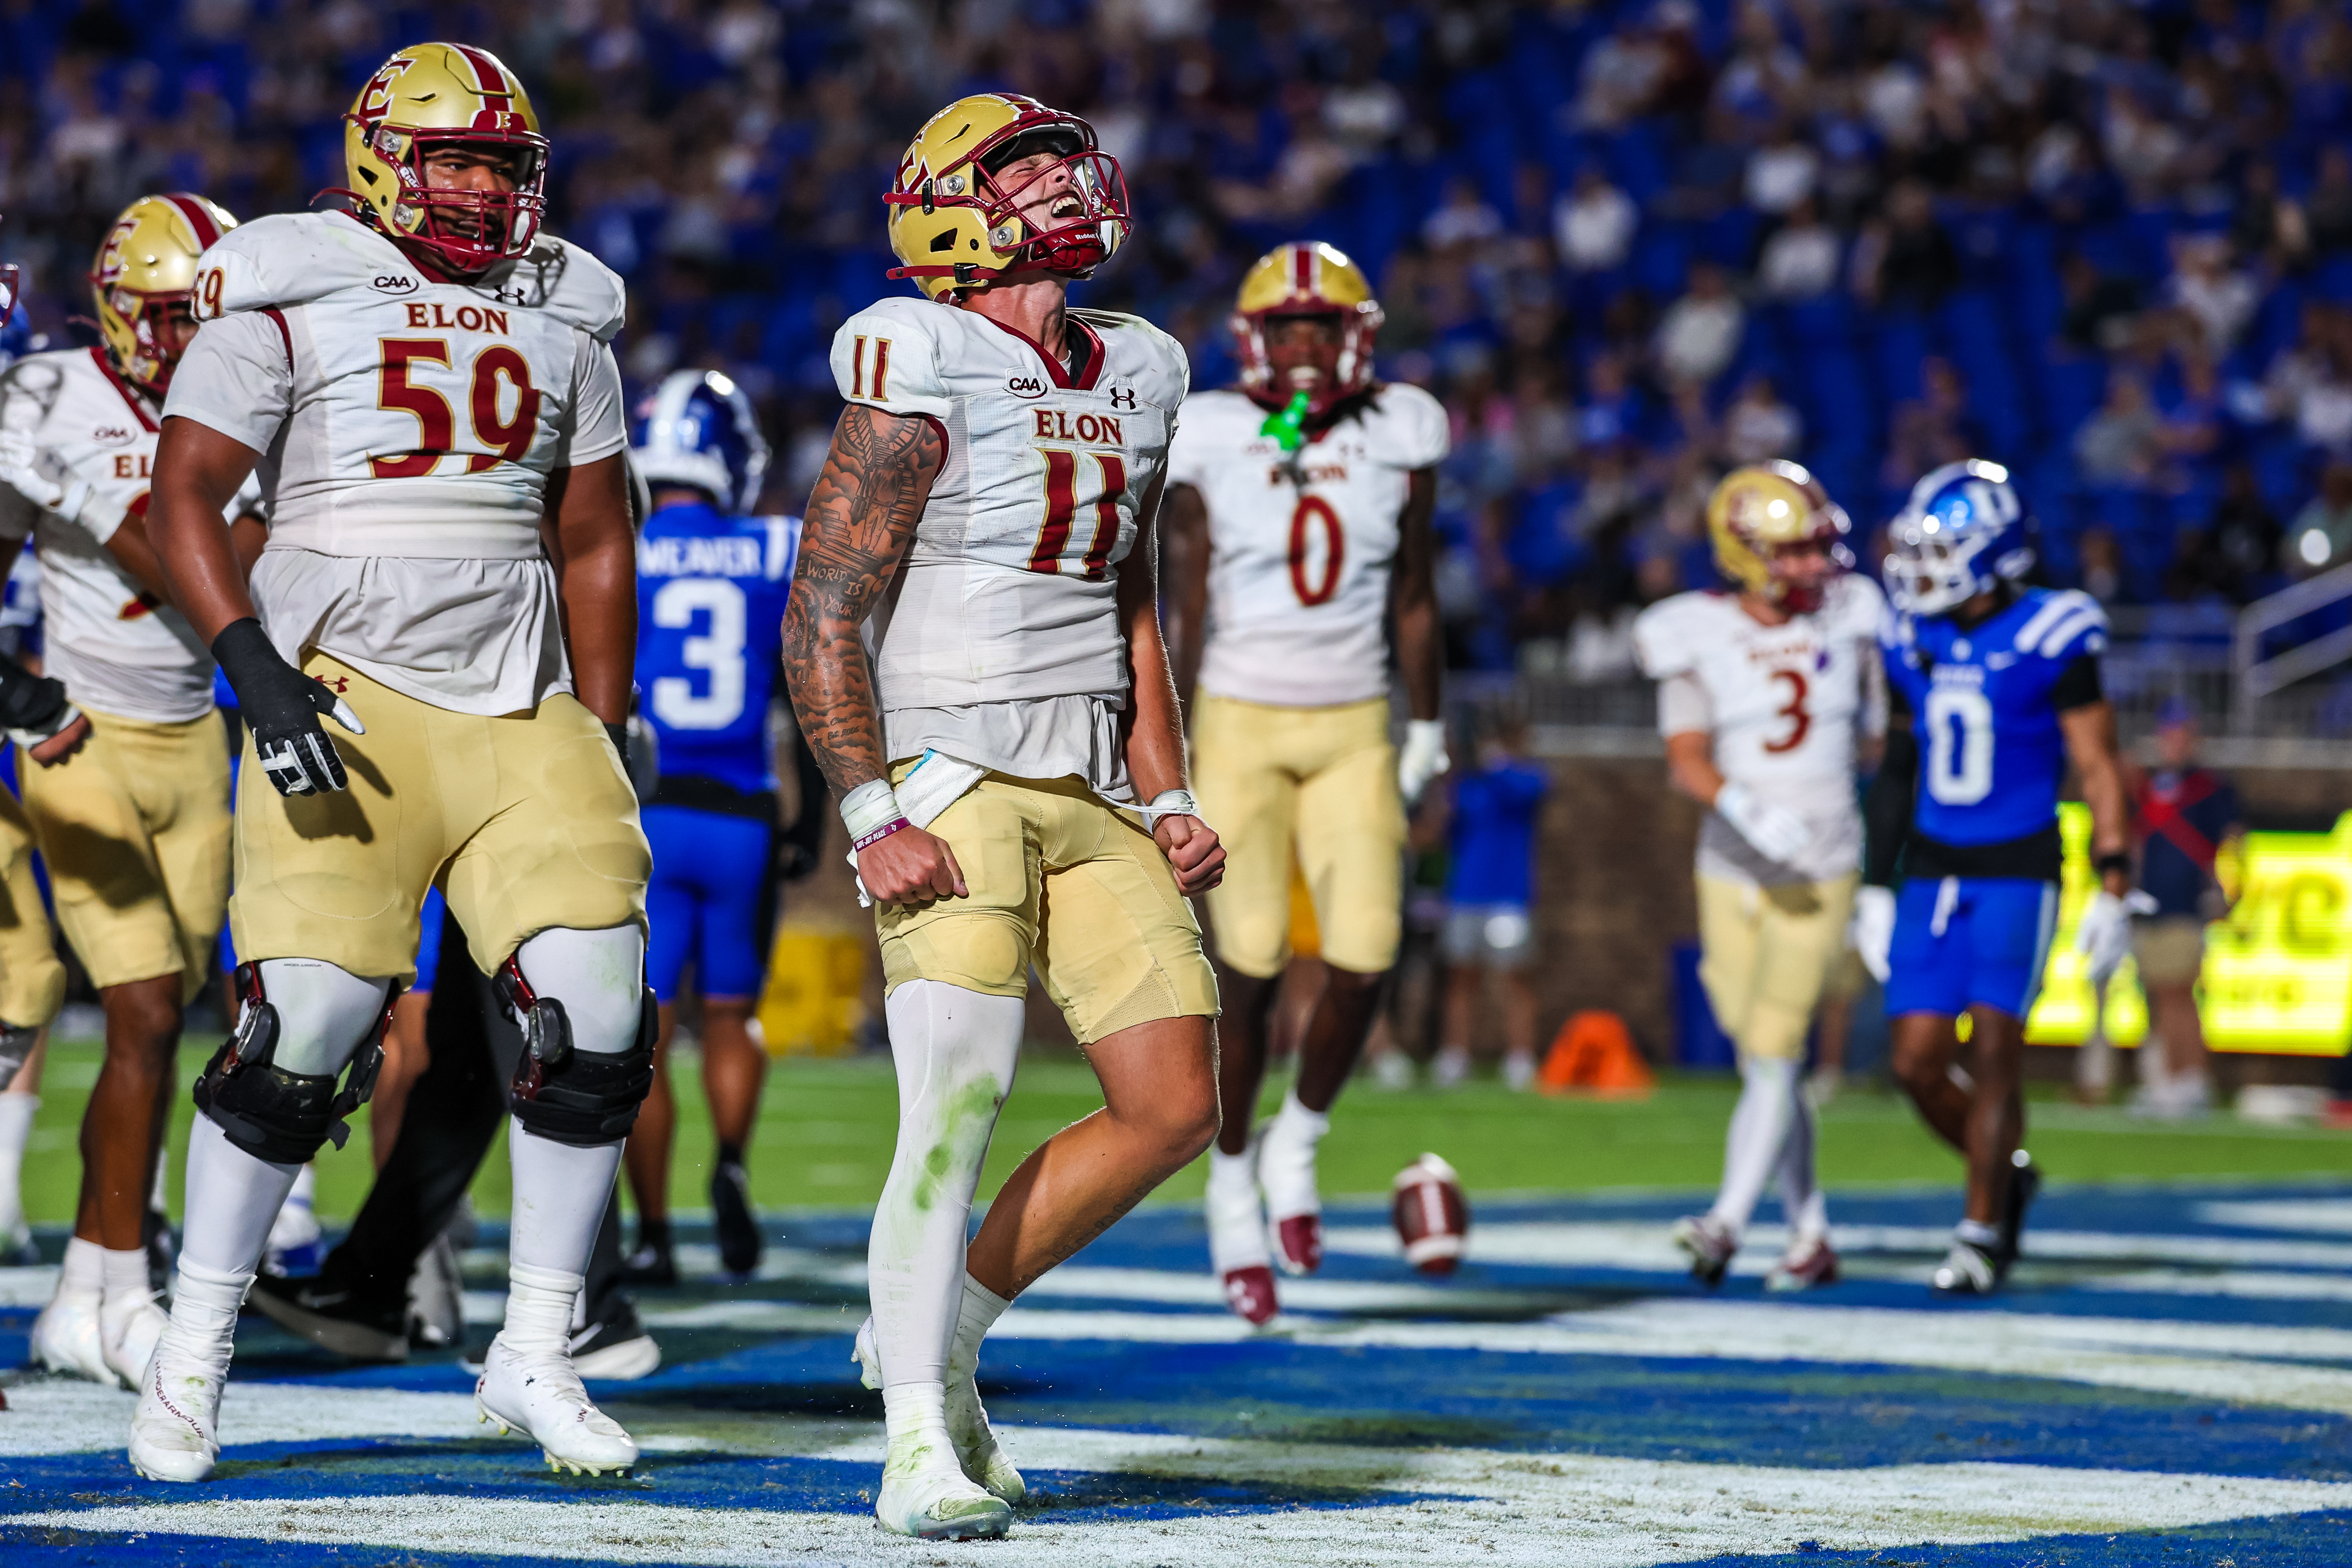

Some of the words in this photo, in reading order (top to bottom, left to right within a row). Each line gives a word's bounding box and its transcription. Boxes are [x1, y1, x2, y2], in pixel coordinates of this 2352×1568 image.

[374, 276, 411, 288] CAA
[403, 303, 509, 336] ELON
[850, 335, 892, 402] 11
[1009, 377, 1041, 392] CAA
[366, 337, 542, 479] 59
[1034, 408, 1122, 445] ELON
[115, 455, 152, 478] EL
[1027, 447, 1127, 581] 11
[1288, 494, 1344, 606] 0
[652, 577, 747, 731] 3
[1762, 668, 1811, 754] 3
[1924, 688, 1995, 806] 0
